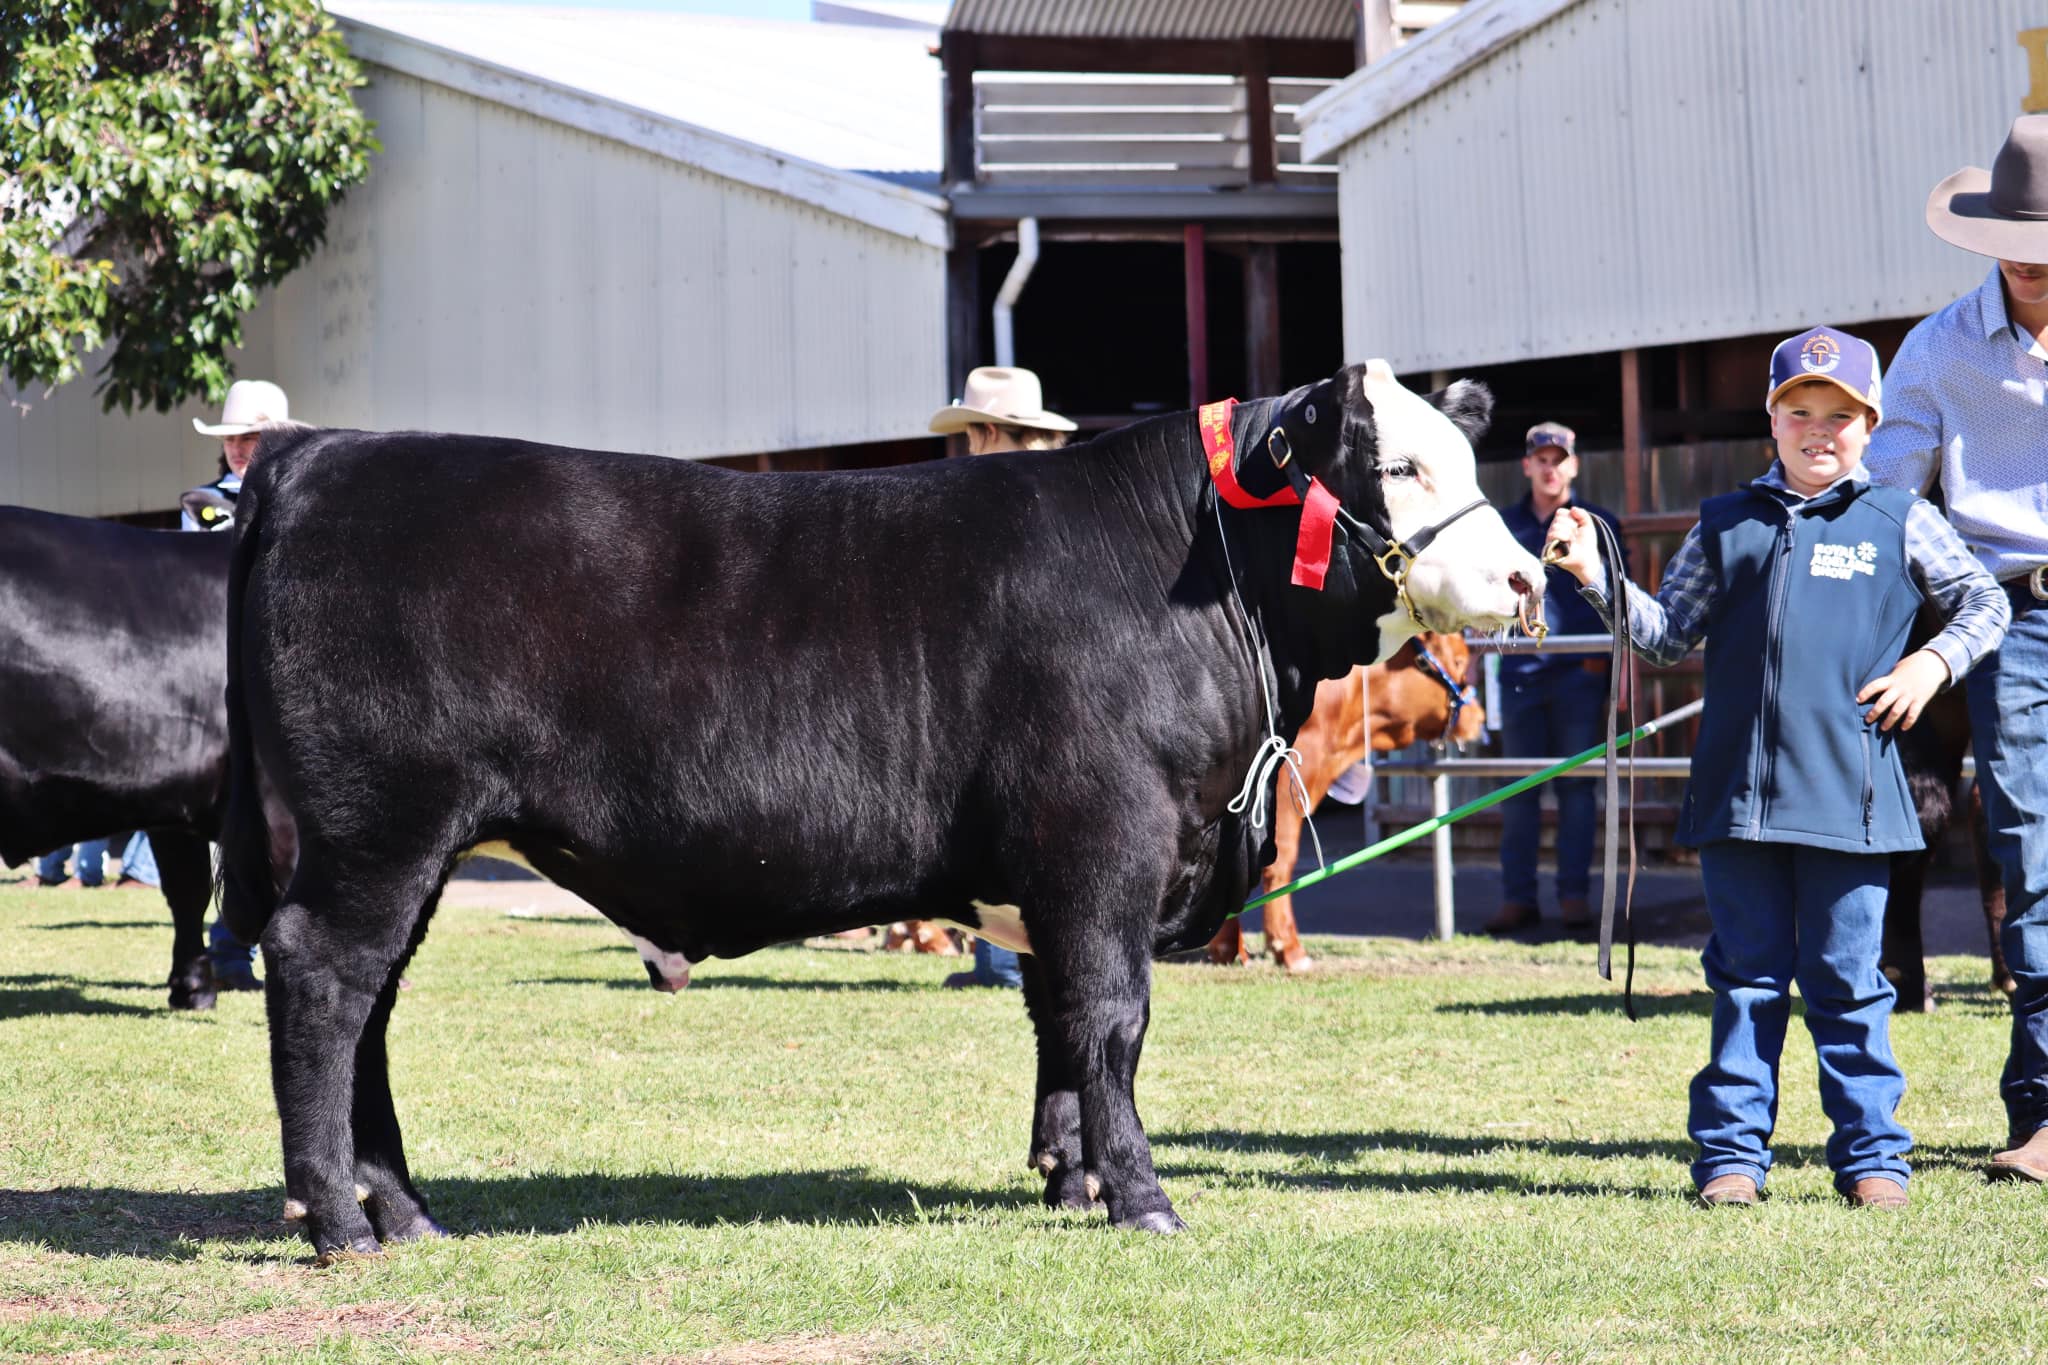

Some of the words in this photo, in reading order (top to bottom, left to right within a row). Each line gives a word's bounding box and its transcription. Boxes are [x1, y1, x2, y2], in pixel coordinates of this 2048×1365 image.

[1814, 543, 1857, 560] ROYAL
[1810, 554, 1876, 576] ADELAIDE
[1810, 565, 1854, 580] SHOW
